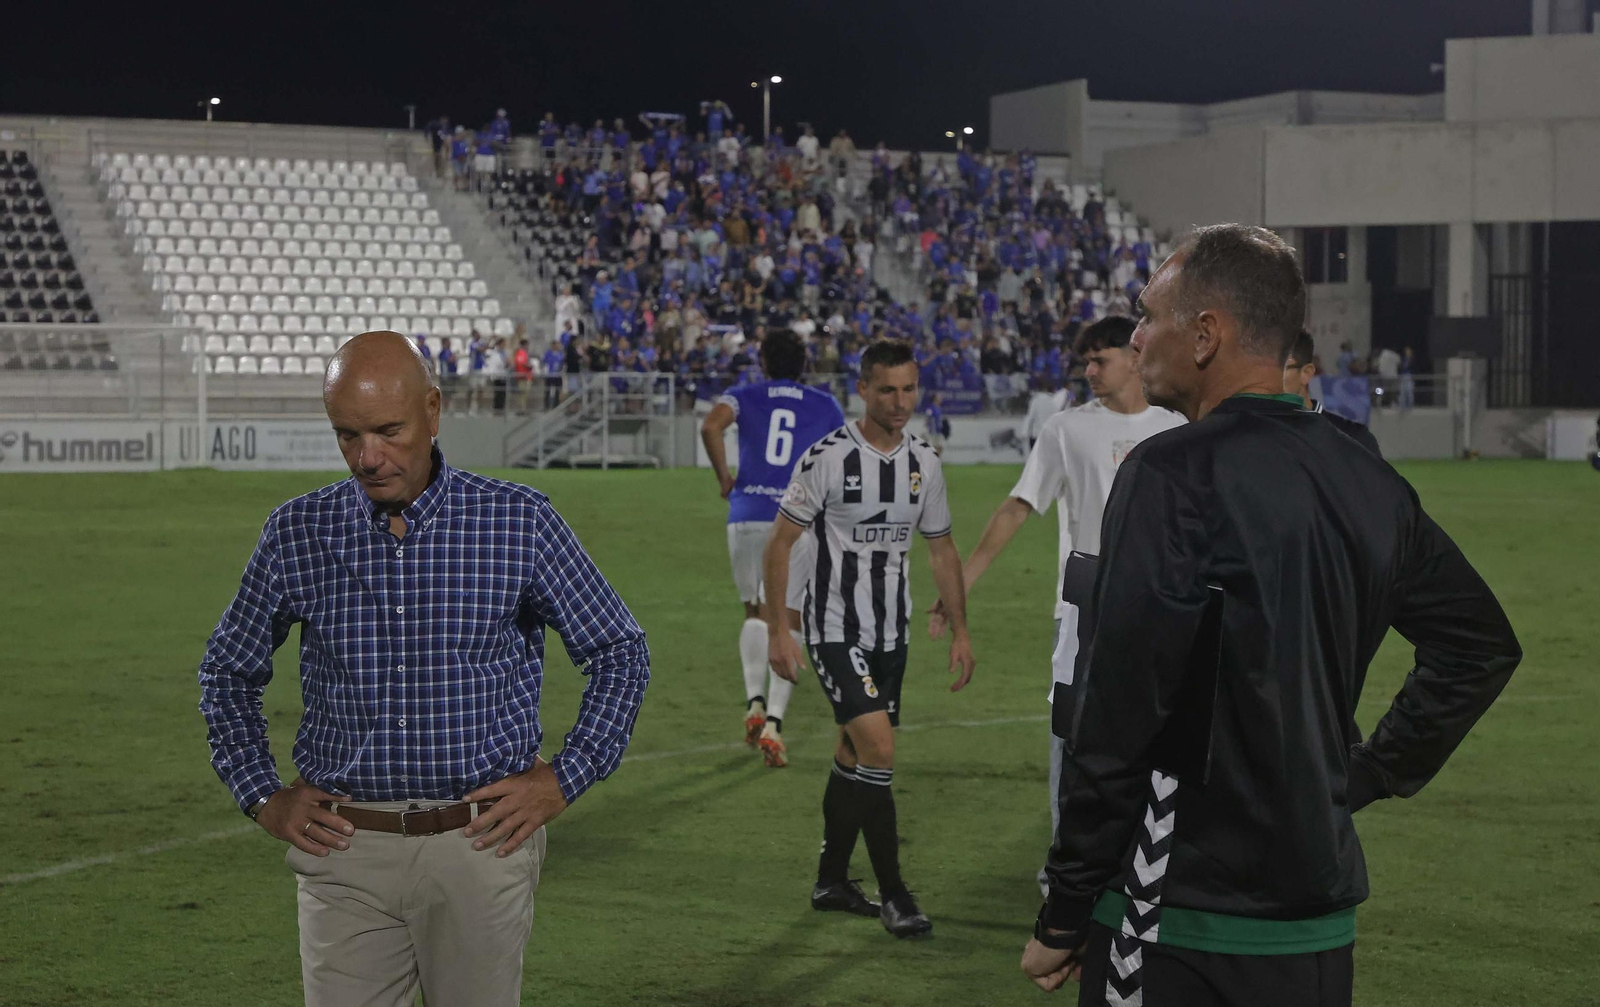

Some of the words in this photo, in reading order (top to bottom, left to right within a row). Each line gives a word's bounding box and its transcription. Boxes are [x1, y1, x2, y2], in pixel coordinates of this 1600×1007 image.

[22, 431, 153, 462] hummel
[765, 408, 796, 466] 6
[853, 527, 909, 543] LOTUS
[849, 646, 870, 677] 6
